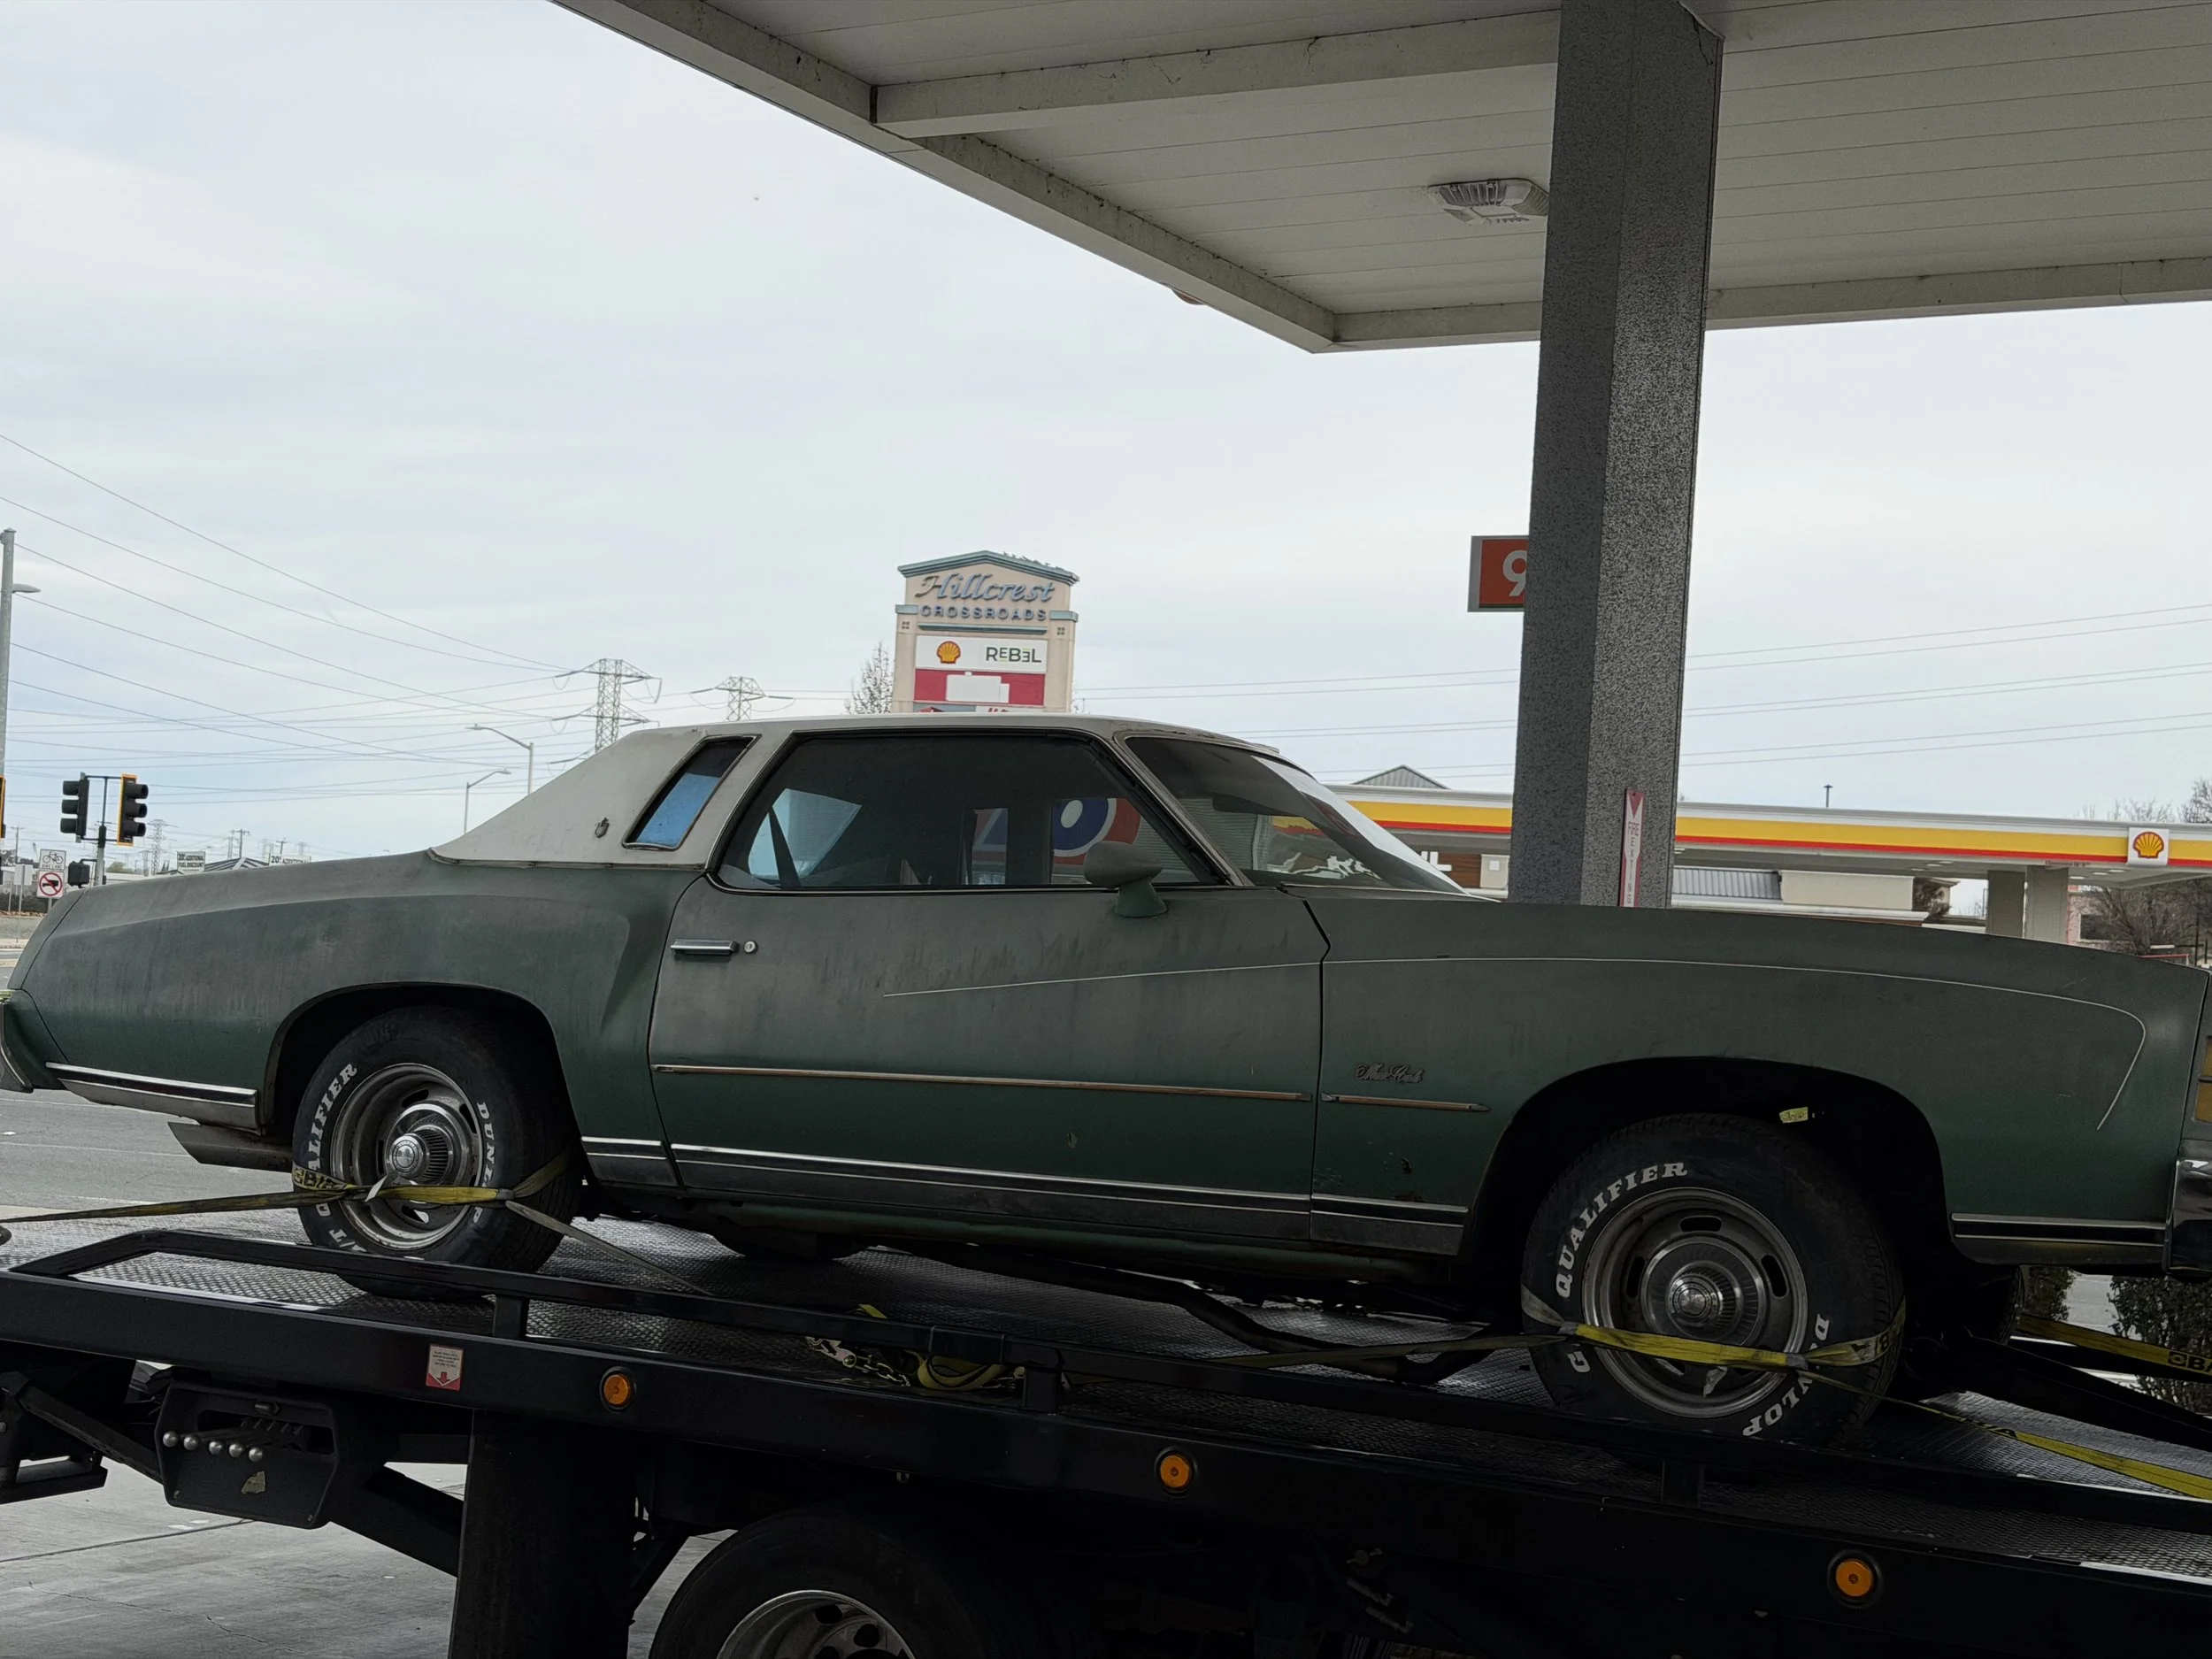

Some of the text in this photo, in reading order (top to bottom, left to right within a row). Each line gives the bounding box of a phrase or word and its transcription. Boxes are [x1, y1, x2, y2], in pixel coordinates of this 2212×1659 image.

[915, 573, 1056, 602] Hillcrest
[919, 604, 1047, 621] CROSSROADS
[473, 1102, 495, 1224] DUNLP
[1555, 1162, 1688, 1299] QUALIFIER
